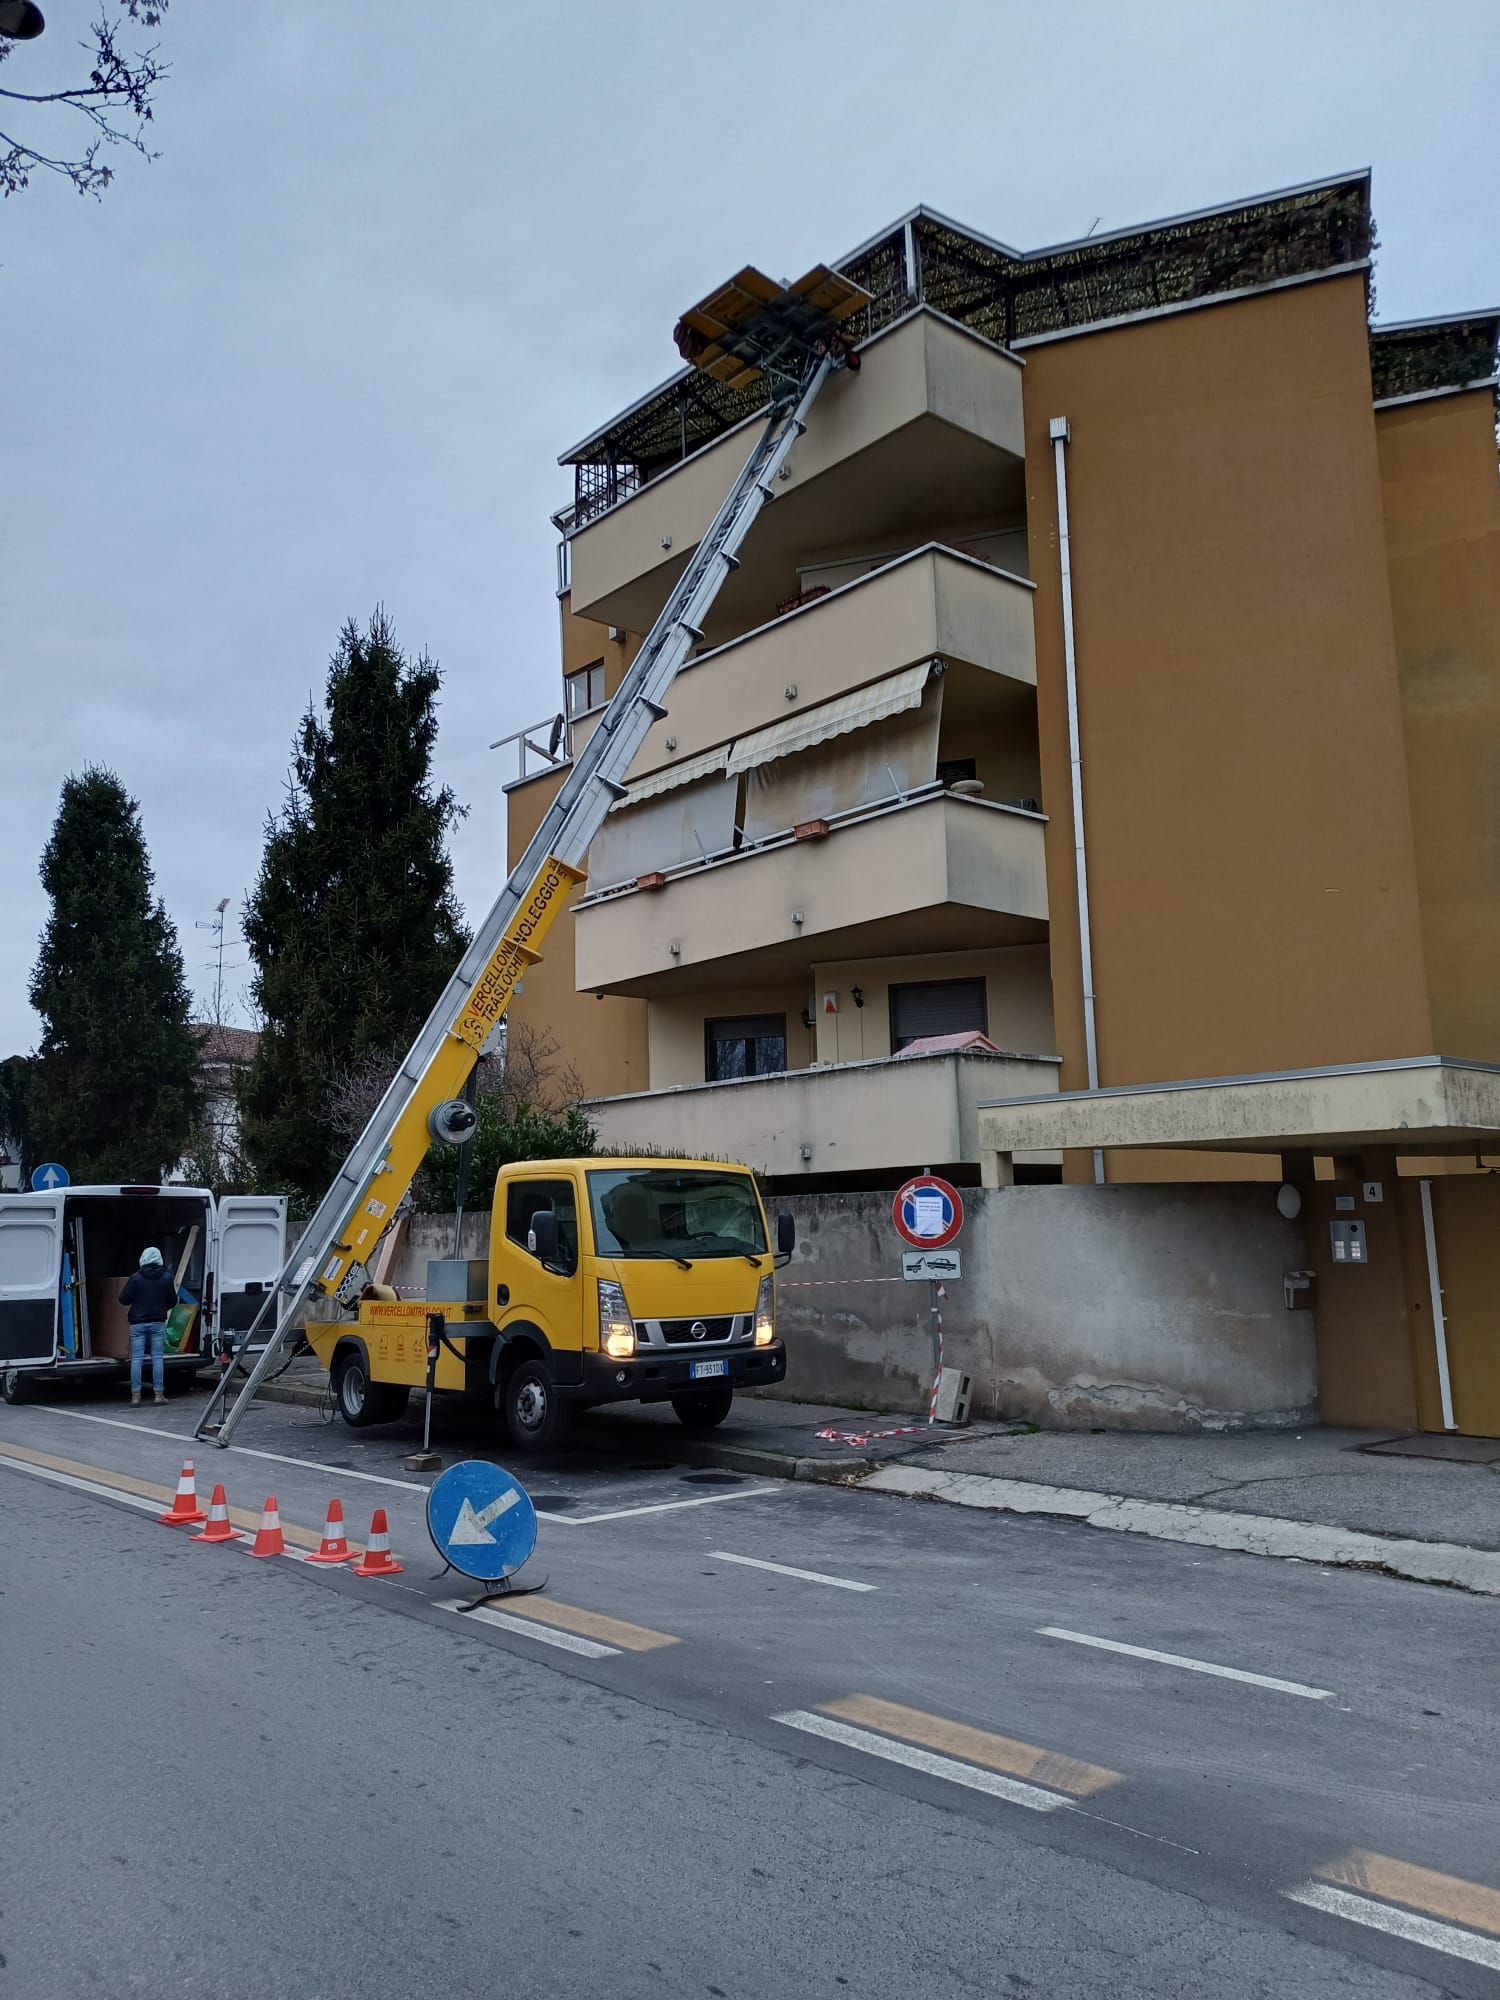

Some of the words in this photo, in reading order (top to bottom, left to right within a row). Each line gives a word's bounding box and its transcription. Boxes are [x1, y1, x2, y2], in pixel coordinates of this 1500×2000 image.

[513, 872, 560, 947] NOLEGGIO
[467, 939, 517, 1018] VERCELLONI
[480, 951, 524, 1023] TRASLOCHI
[1368, 1186, 1376, 1197] 4
